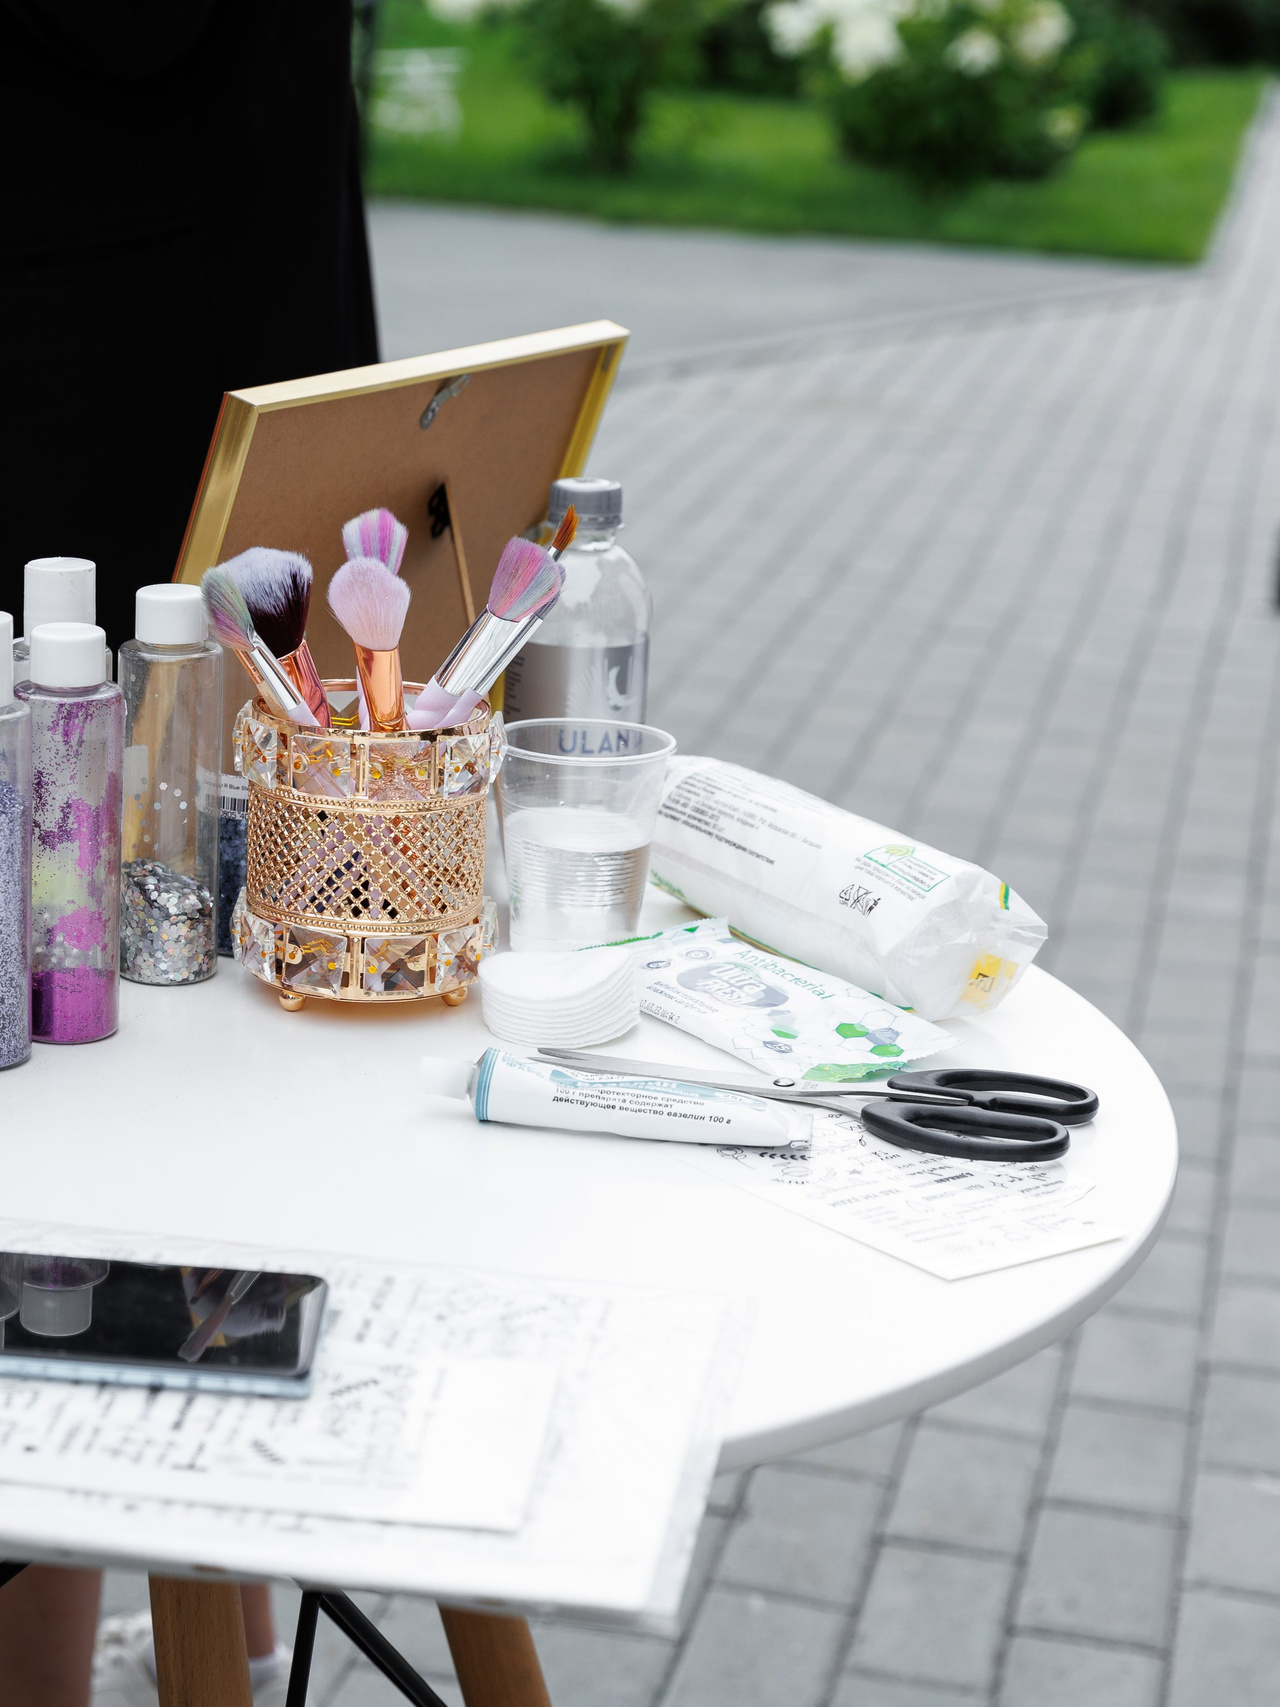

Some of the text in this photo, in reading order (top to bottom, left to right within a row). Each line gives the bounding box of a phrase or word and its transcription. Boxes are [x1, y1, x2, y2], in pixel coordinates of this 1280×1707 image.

[709, 964, 767, 996] Ultra
[734, 950, 835, 1001] Antibacterial
[696, 978, 757, 1006] FRESH
[552, 1095, 617, 1110] действующее
[618, 1105, 664, 1116] вещество
[666, 1111, 706, 1121] вазелин
[708, 1115, 724, 1124] 100
[578, 1091, 628, 1104] препарата
[628, 1098, 674, 1109] содержат
[660, 1096, 705, 1106] средство
